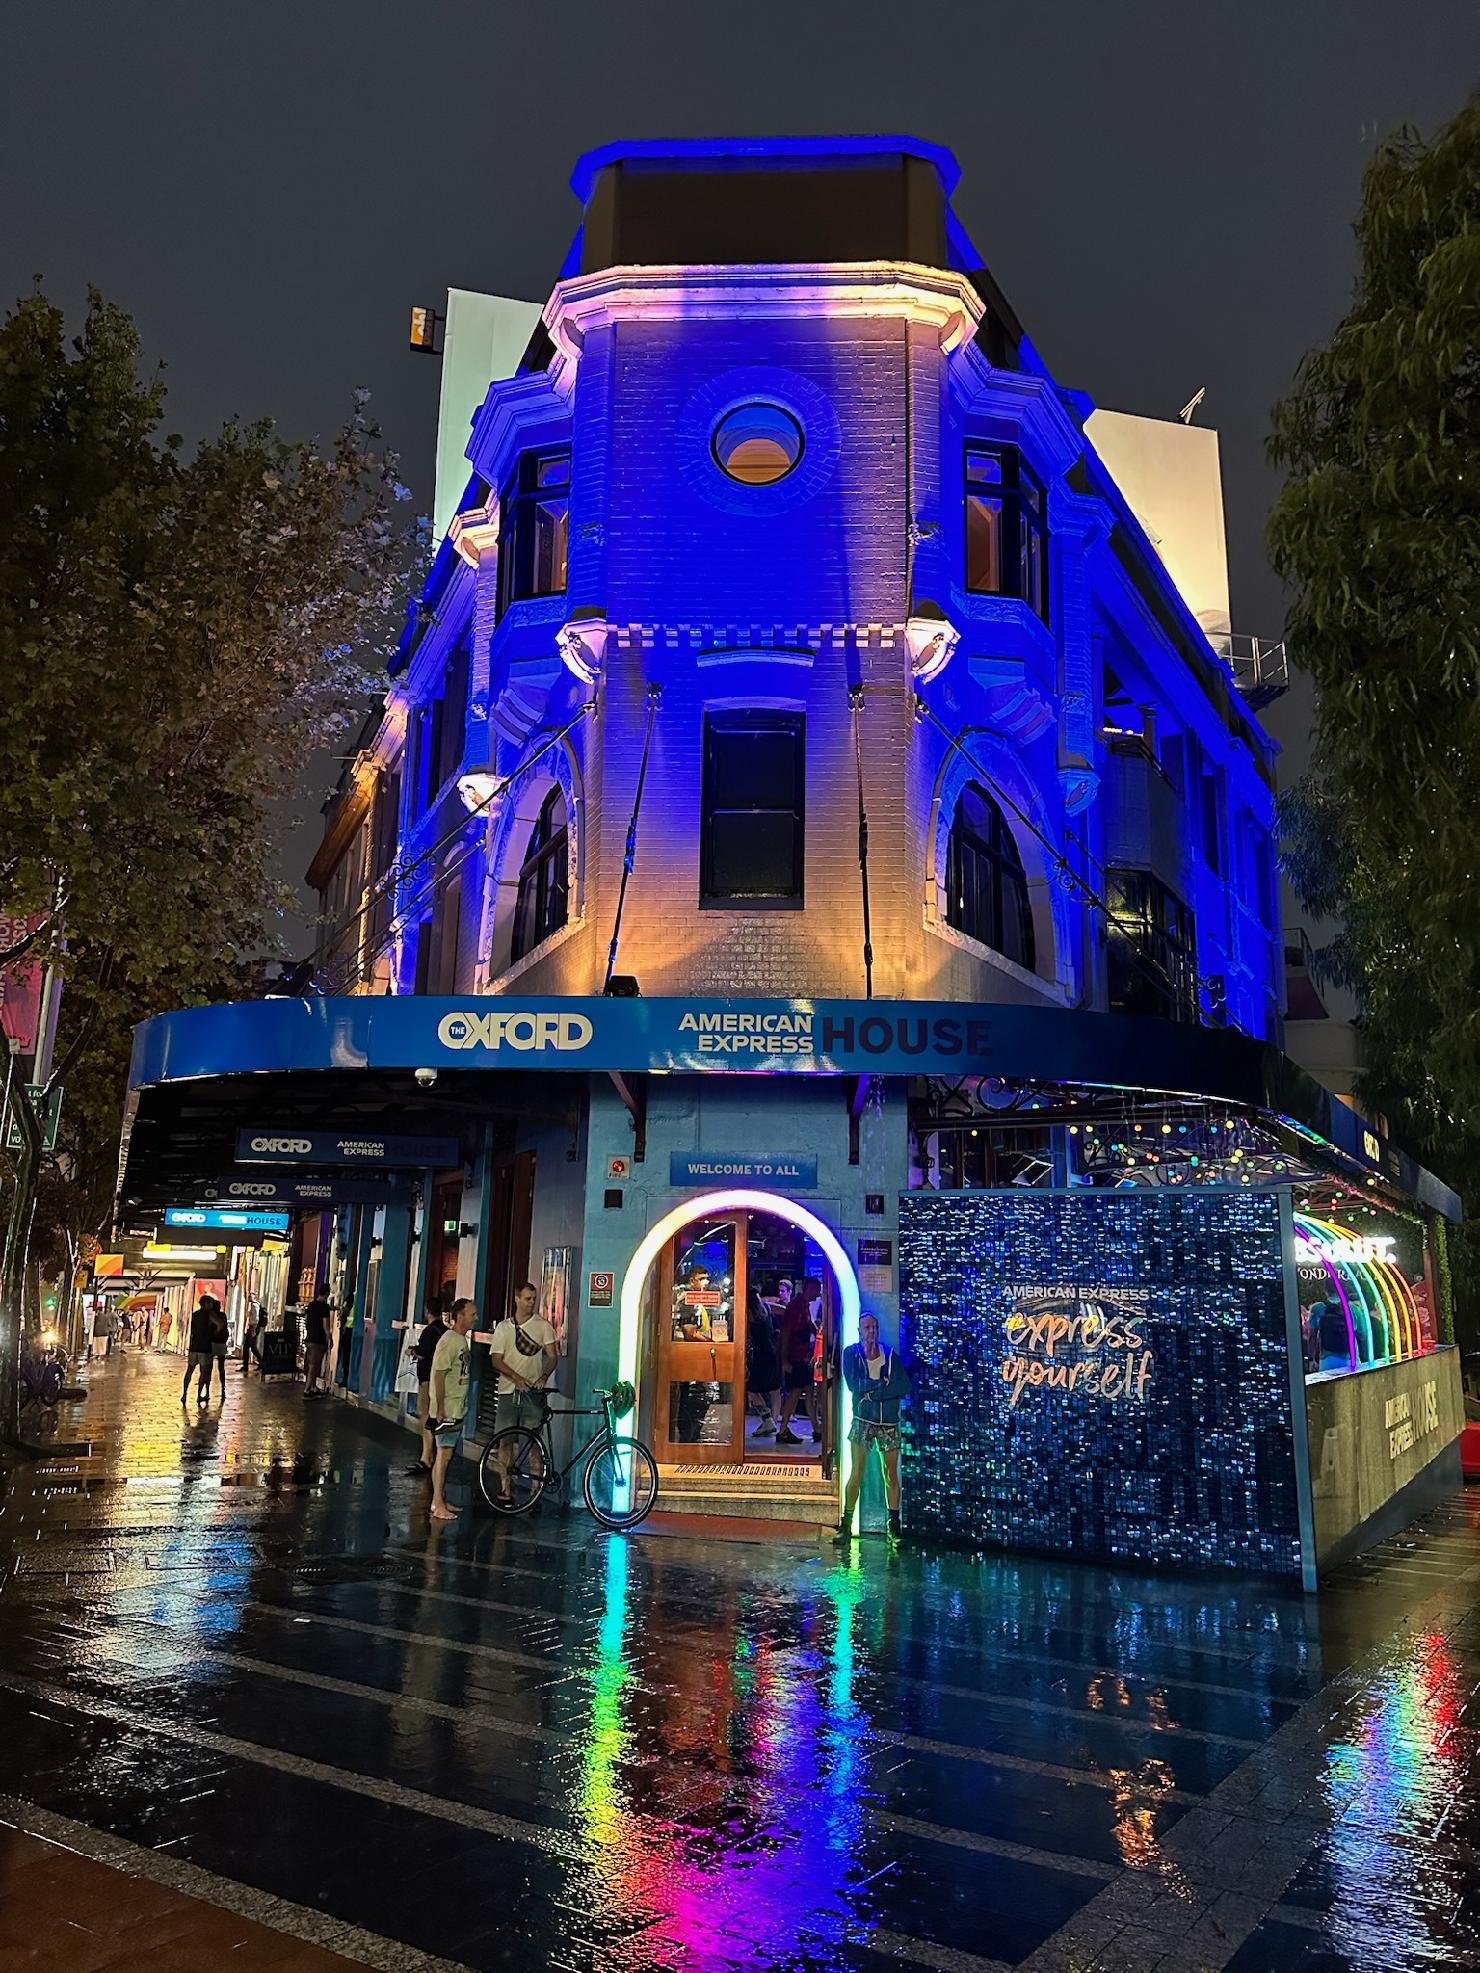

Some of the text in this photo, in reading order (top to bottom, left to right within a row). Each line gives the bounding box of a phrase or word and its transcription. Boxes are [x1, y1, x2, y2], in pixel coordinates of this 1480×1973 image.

[437, 1012, 593, 1050] OXFORD
[451, 1026, 465, 1035] THE
[678, 1013, 812, 1033] AMERICAN
[698, 1034, 813, 1053] EXPRESS
[822, 1017, 992, 1056] HOUSE
[251, 1137, 312, 1153] OXFORD
[337, 1141, 385, 1149] AMERICAN
[343, 1148, 385, 1157] EXPRESS
[688, 1164, 799, 1176] WELCOME TO ALL
[229, 1183, 277, 1196] OXFORD
[247, 1217, 281, 1225] HOUSE
[1003, 1285, 1149, 1301] AMERICAN EXPRESS
[1007, 1313, 1144, 1357] express
[1001, 1351, 1153, 1410] yourself
